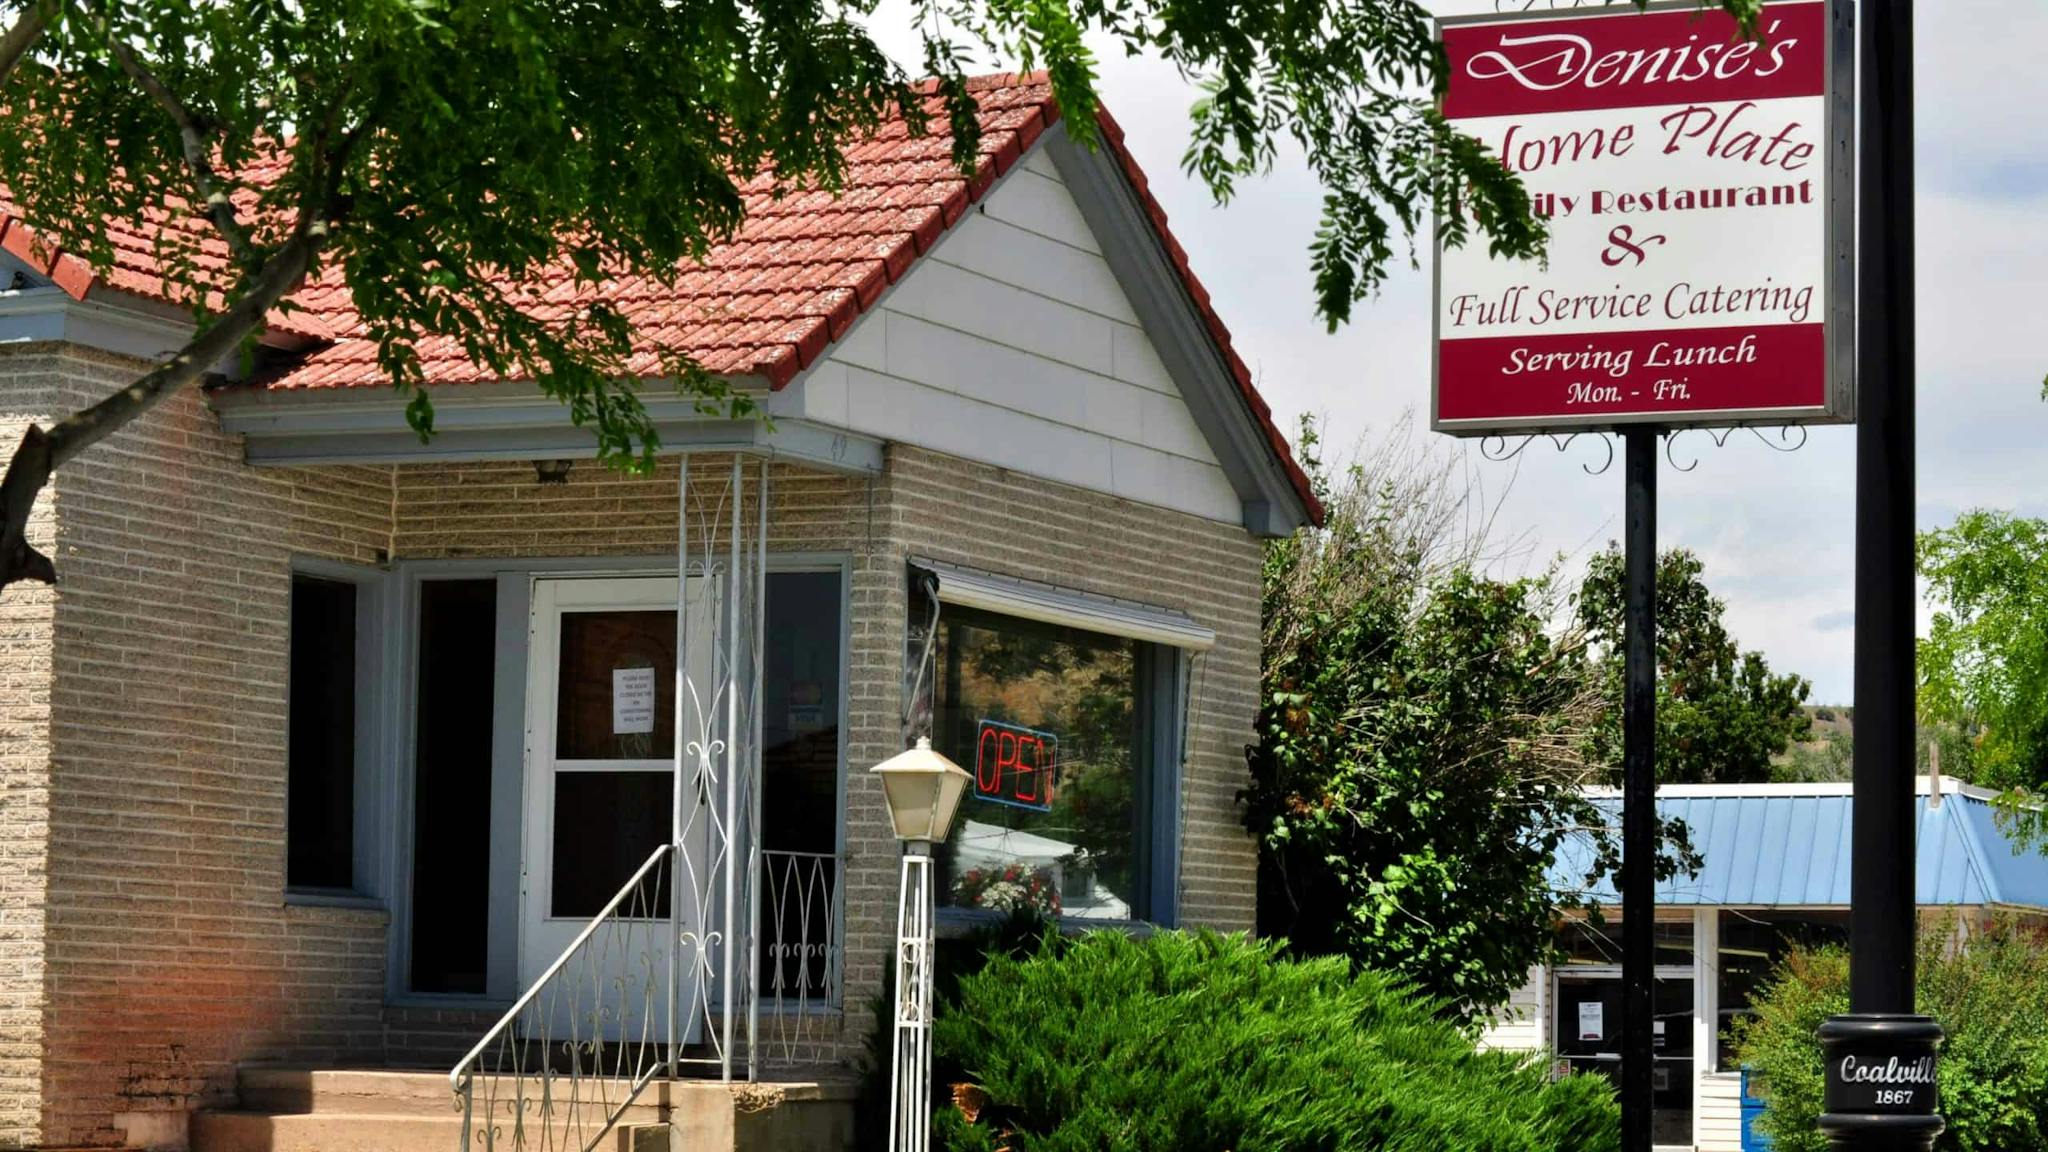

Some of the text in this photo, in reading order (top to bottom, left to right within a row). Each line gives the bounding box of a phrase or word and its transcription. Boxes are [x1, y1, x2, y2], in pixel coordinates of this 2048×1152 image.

[1466, 20, 1797, 91] Denise's
[1660, 101, 1815, 171] Plate
[1592, 179, 1814, 214] Restaurant
[1600, 224, 1666, 267] &
[1450, 277, 1814, 326] Full Service Catering
[1501, 334, 1757, 377] Serving Lunch
[1566, 382, 1623, 405] Mon.
[1653, 378, 1691, 401] Fri.
[978, 728, 1055, 804] OPEN
[1874, 1089, 1914, 1105] 1867
